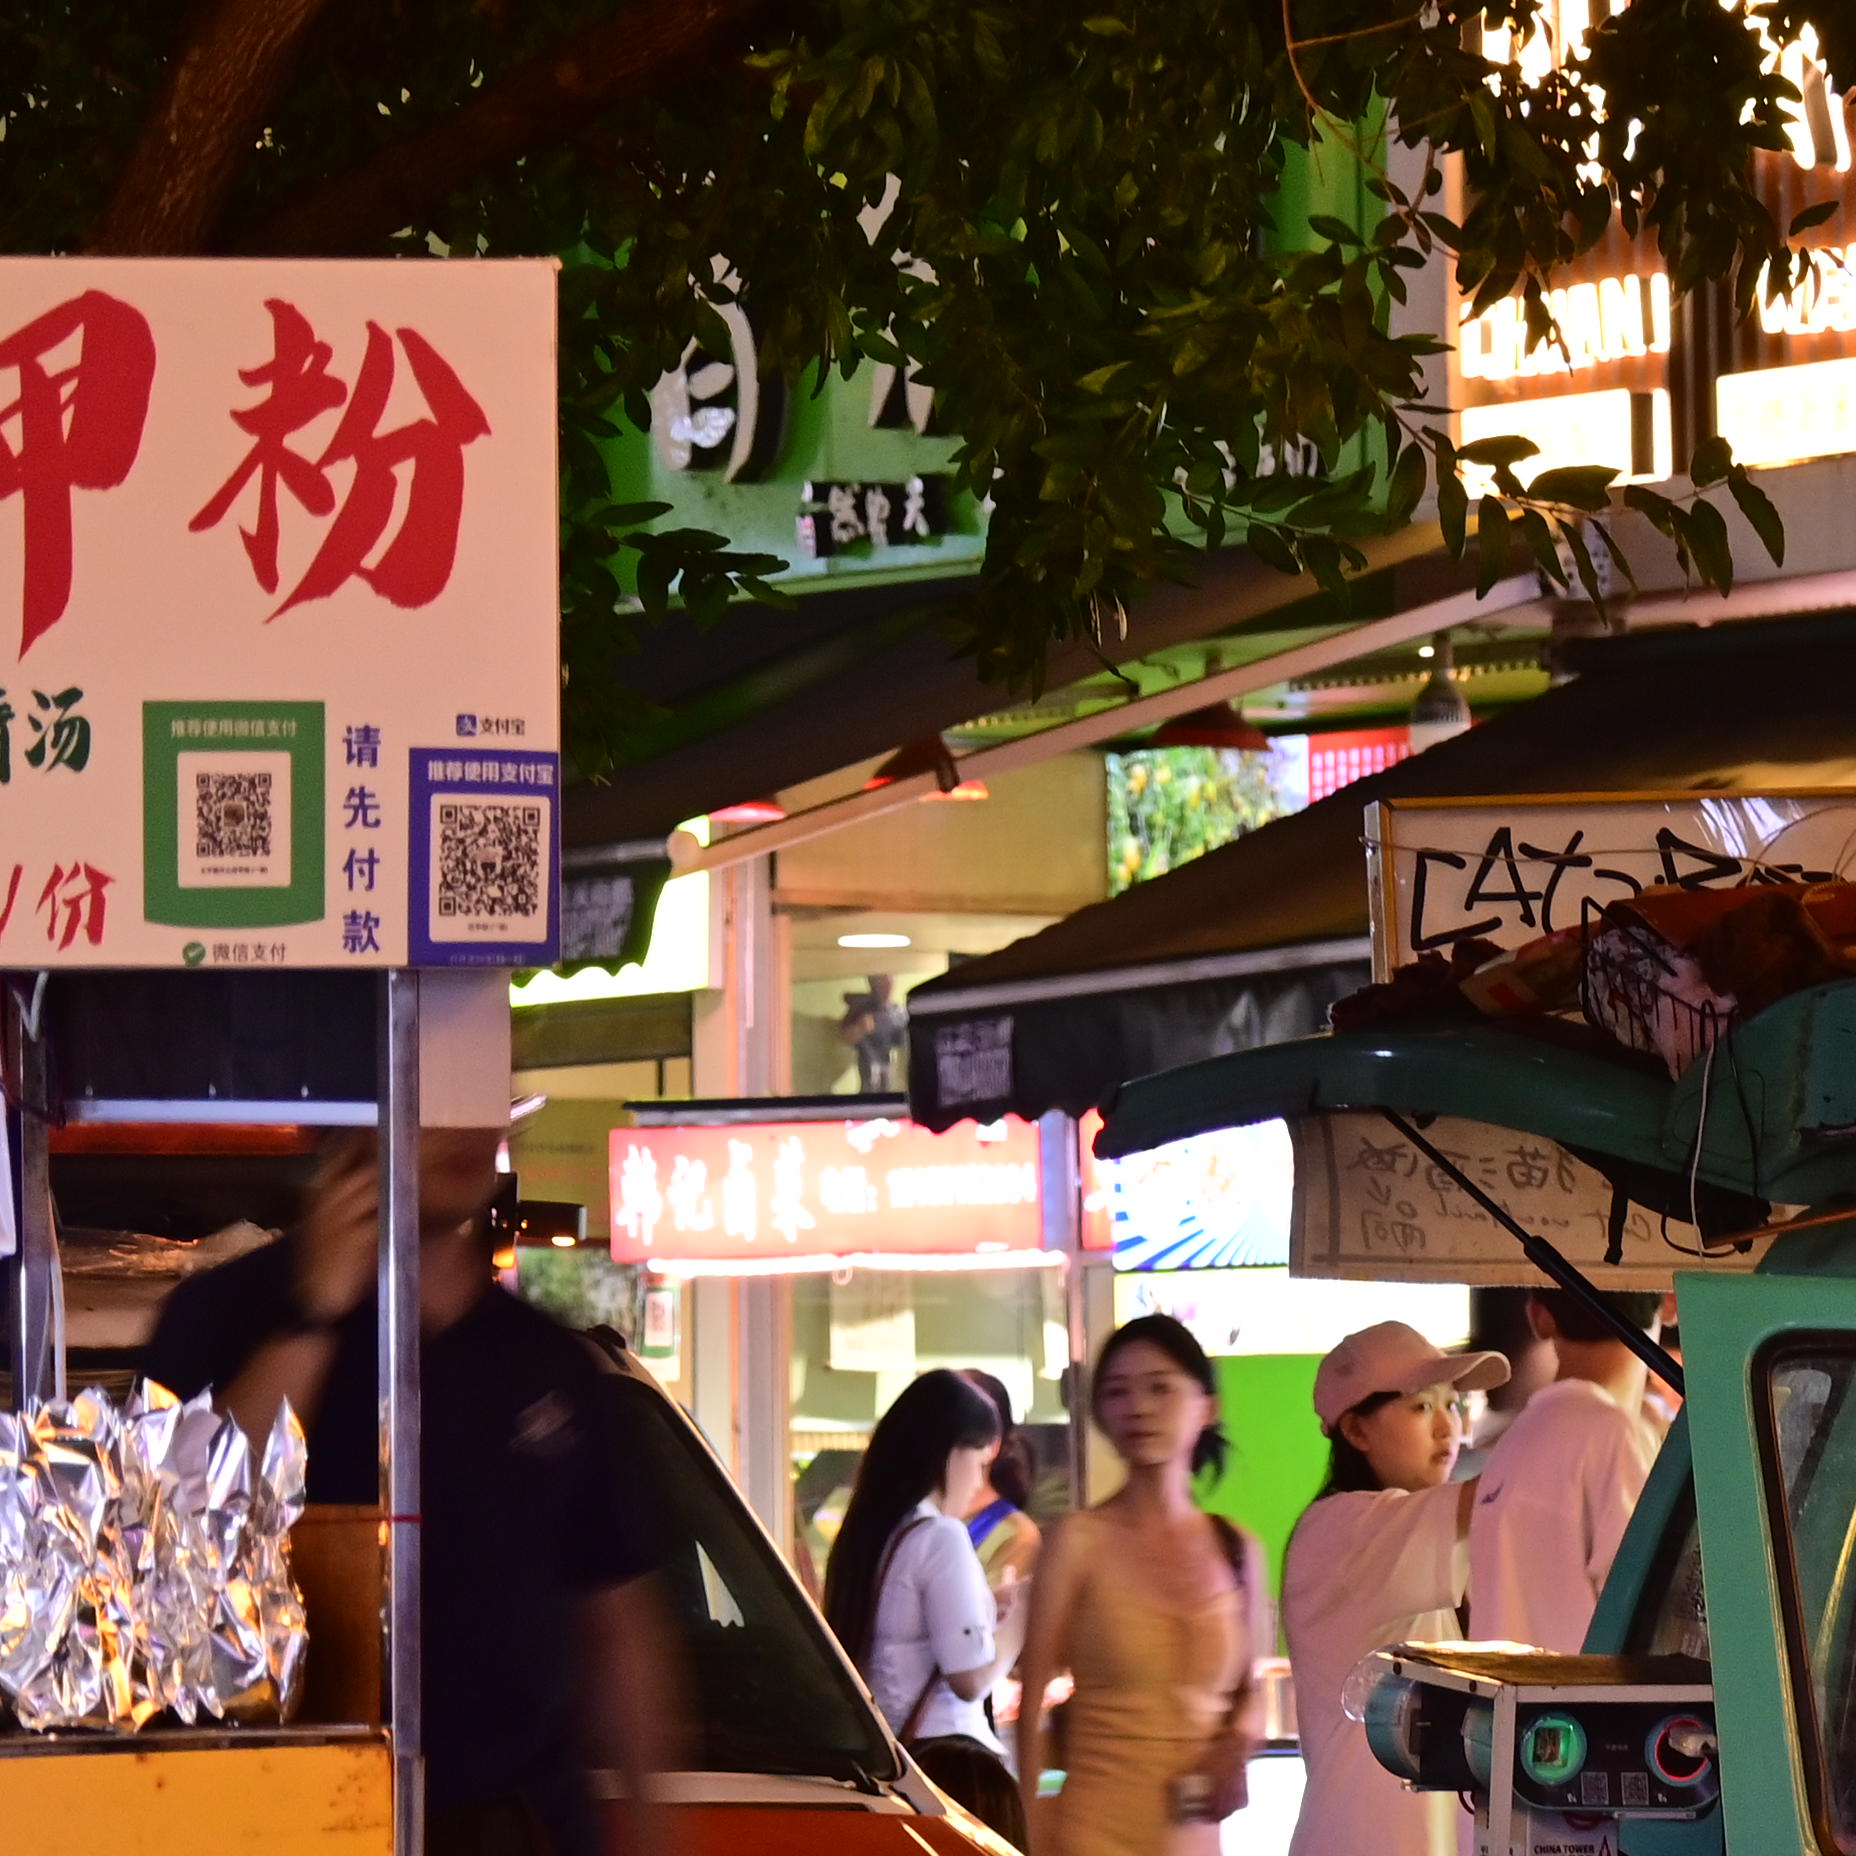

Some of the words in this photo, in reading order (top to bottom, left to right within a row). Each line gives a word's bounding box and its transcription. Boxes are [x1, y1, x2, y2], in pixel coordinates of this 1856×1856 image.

[0, 685, 92, 774] 汤
[427, 760, 555, 786] 推荐使用支付宝
[342, 724, 382, 955] 请先付款
[212, 942, 288, 963] 微信支付
[1534, 1844, 1561, 1855] CHINA
[1563, 1844, 1595, 1854] TOWER
